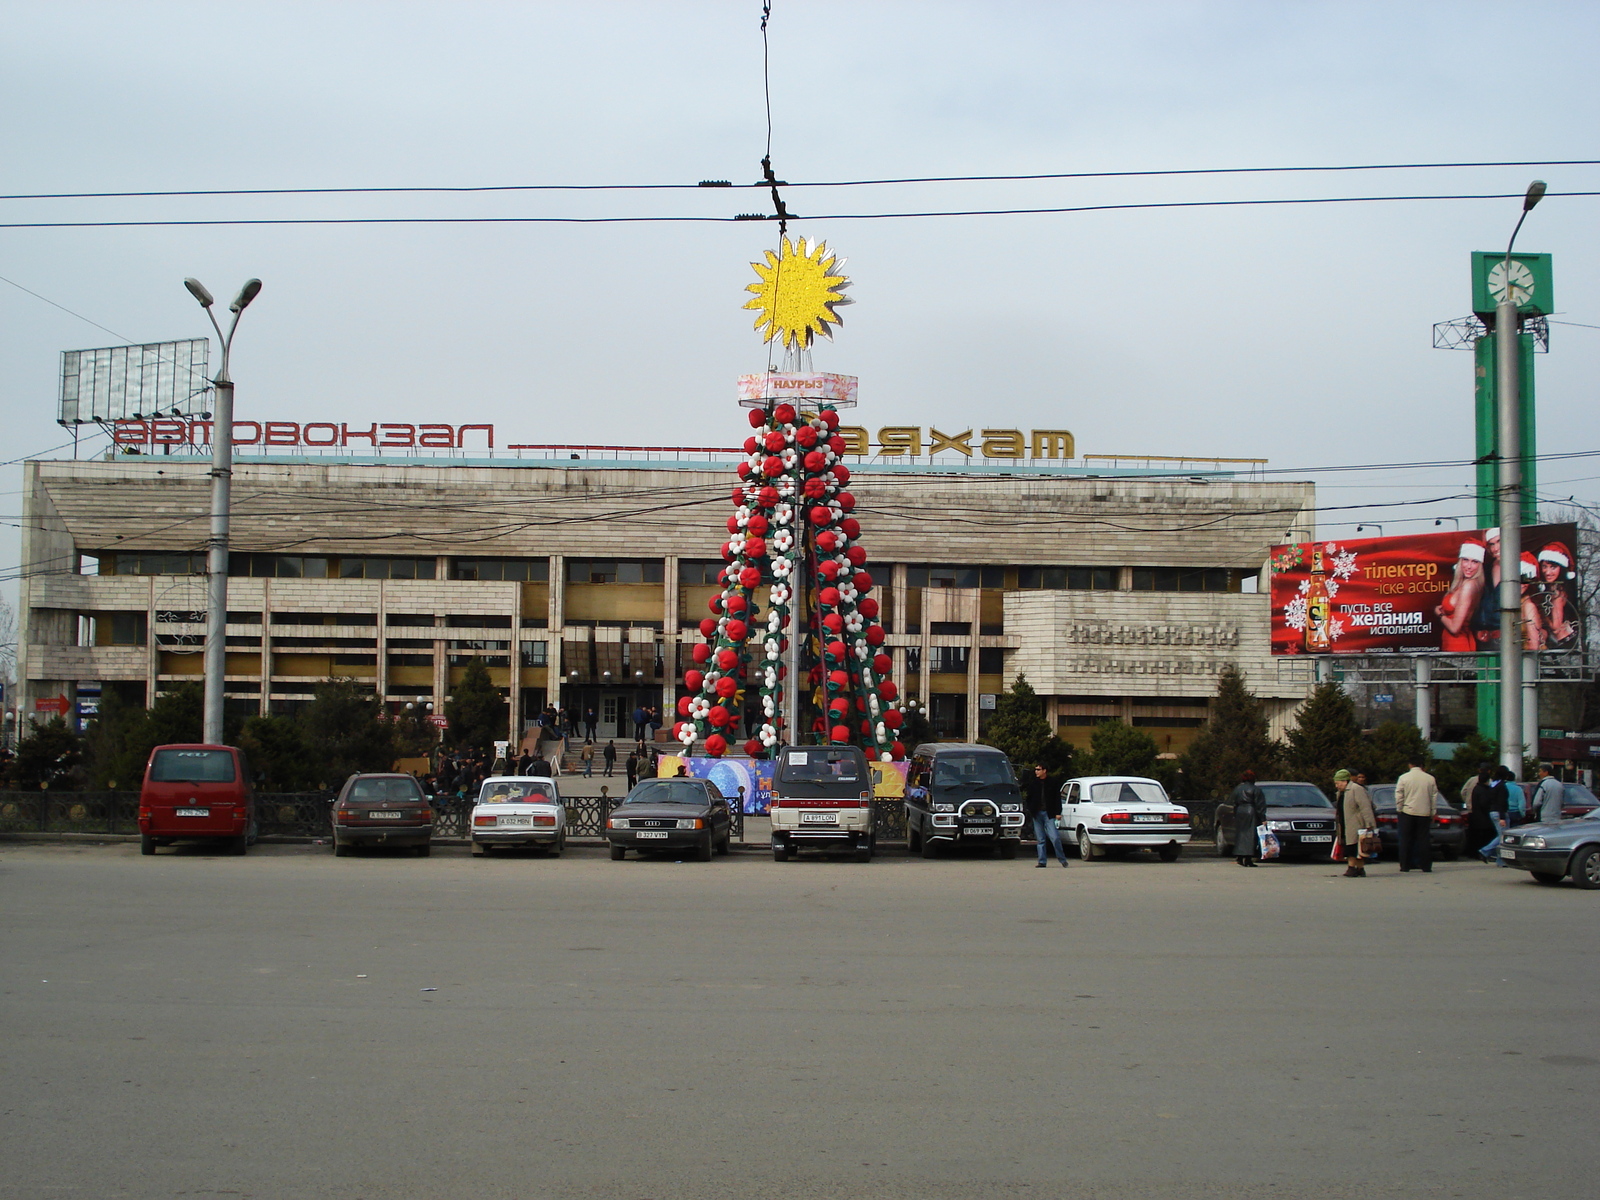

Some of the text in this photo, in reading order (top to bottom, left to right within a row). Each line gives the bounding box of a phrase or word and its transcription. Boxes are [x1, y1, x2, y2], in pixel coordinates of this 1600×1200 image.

[773, 379, 824, 389] НАУРЫЗ
[1364, 562, 1438, 580] тілектер
[1374, 579, 1450, 595] -іске ассын
[1340, 602, 1393, 617] пусть все
[1350, 611, 1423, 627] желания
[1370, 621, 1432, 636] исполнятся!
